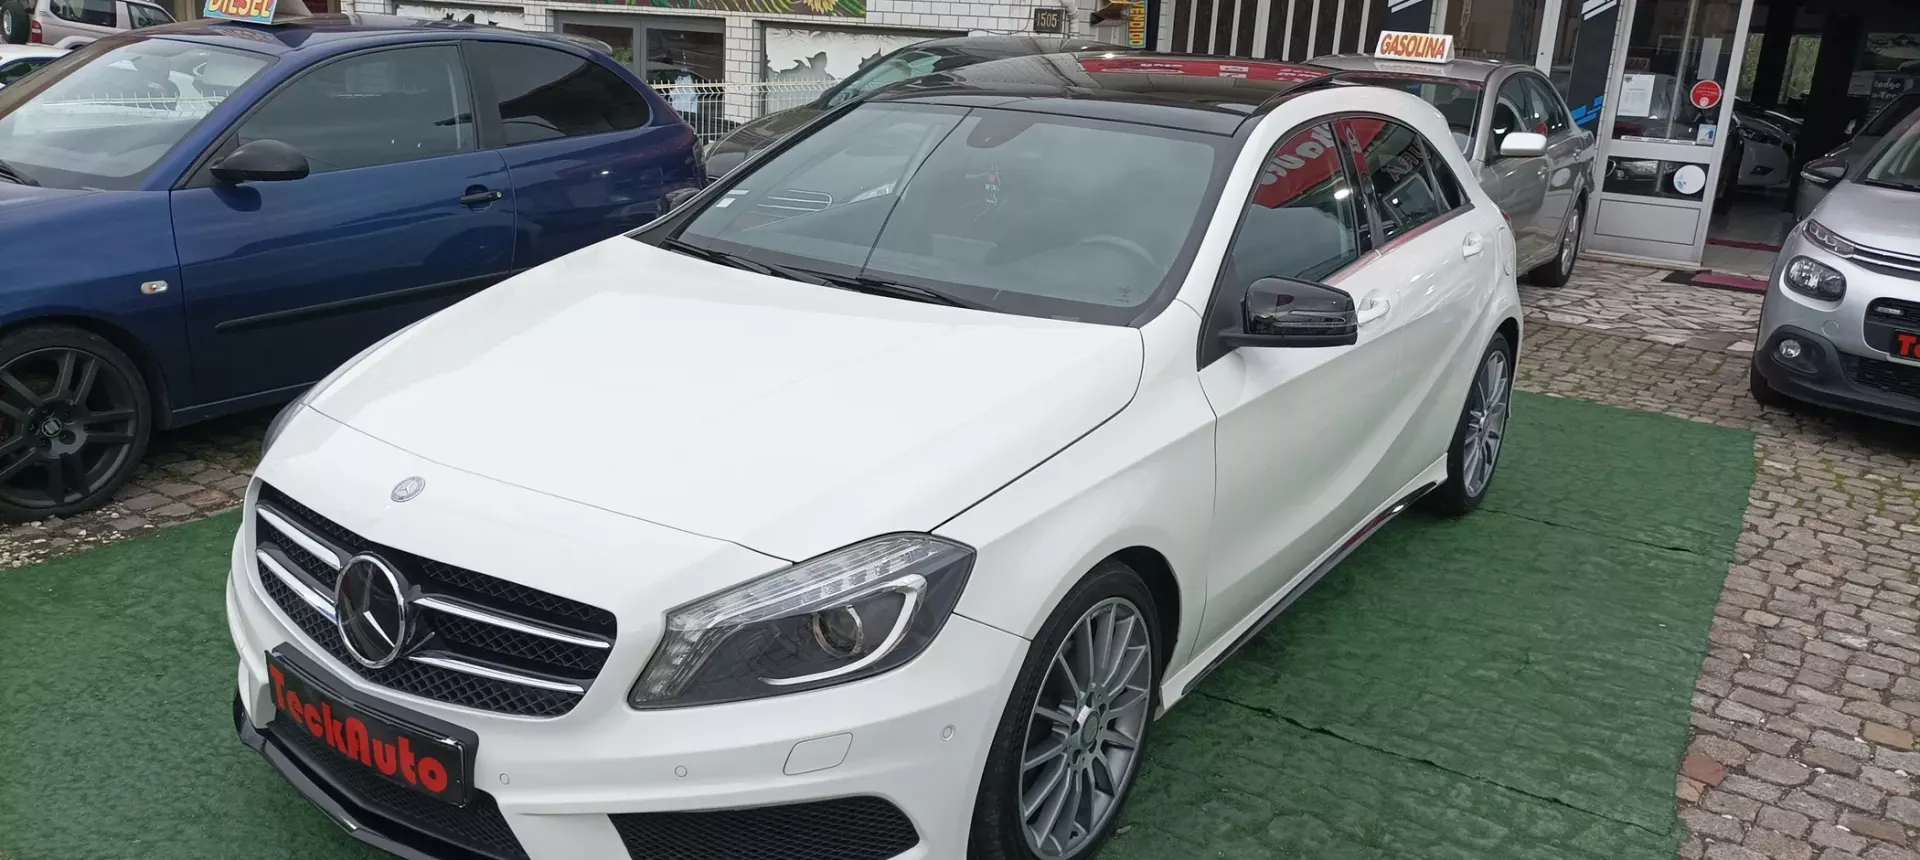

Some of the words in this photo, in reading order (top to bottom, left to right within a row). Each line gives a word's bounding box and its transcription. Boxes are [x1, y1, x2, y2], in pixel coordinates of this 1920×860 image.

[1036, 12, 1058, 28] 1505
[1380, 33, 1446, 59] GASOLINA
[269, 663, 448, 793] TeckAuto
